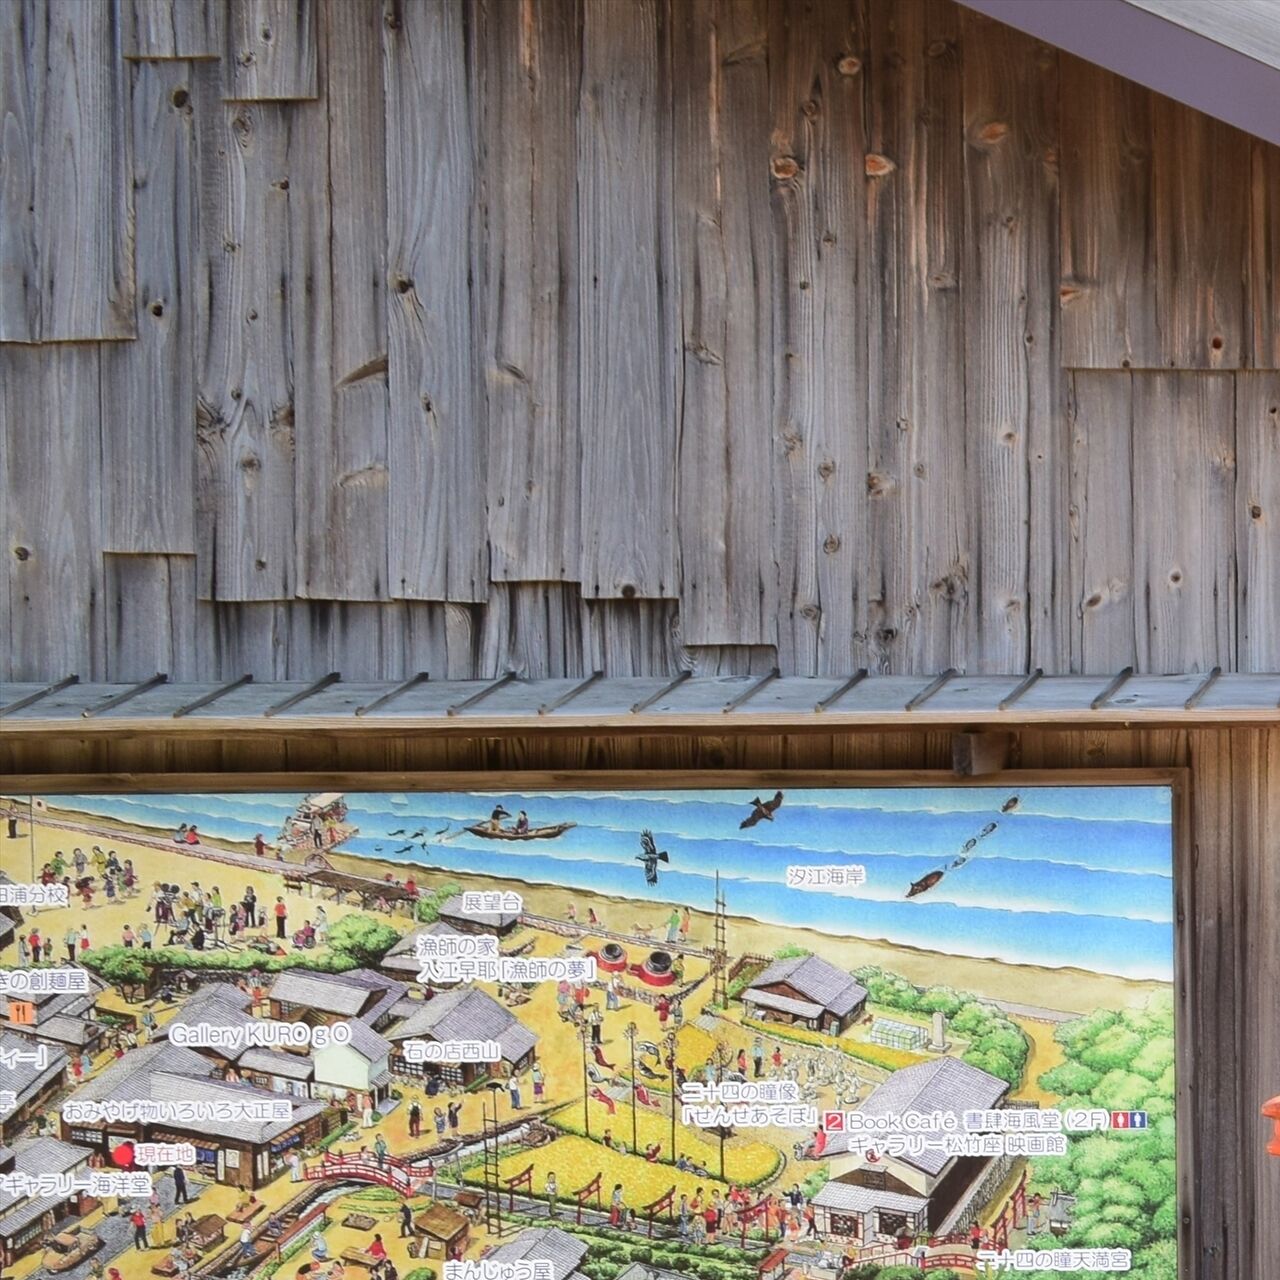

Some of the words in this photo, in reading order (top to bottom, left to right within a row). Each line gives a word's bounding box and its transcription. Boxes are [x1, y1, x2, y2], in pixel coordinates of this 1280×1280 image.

[789, 868, 863, 885] 汐江海岸
[465, 895, 520, 911] 展望台
[420, 938, 496, 957] 漁師の家
[172, 1025, 241, 1045] Gallery
[407, 1043, 500, 1059] 石の店西山
[682, 1083, 796, 1100] 二十四の瞳像
[65, 1102, 290, 1120] おみやげ物いろいろ大正屋
[850, 1113, 899, 1129] Book
[138, 1146, 194, 1163] 現在地
[979, 1251, 1129, 1269] 二十四の瞳天満宮
[446, 1262, 552, 1280] まんじゅう屋
